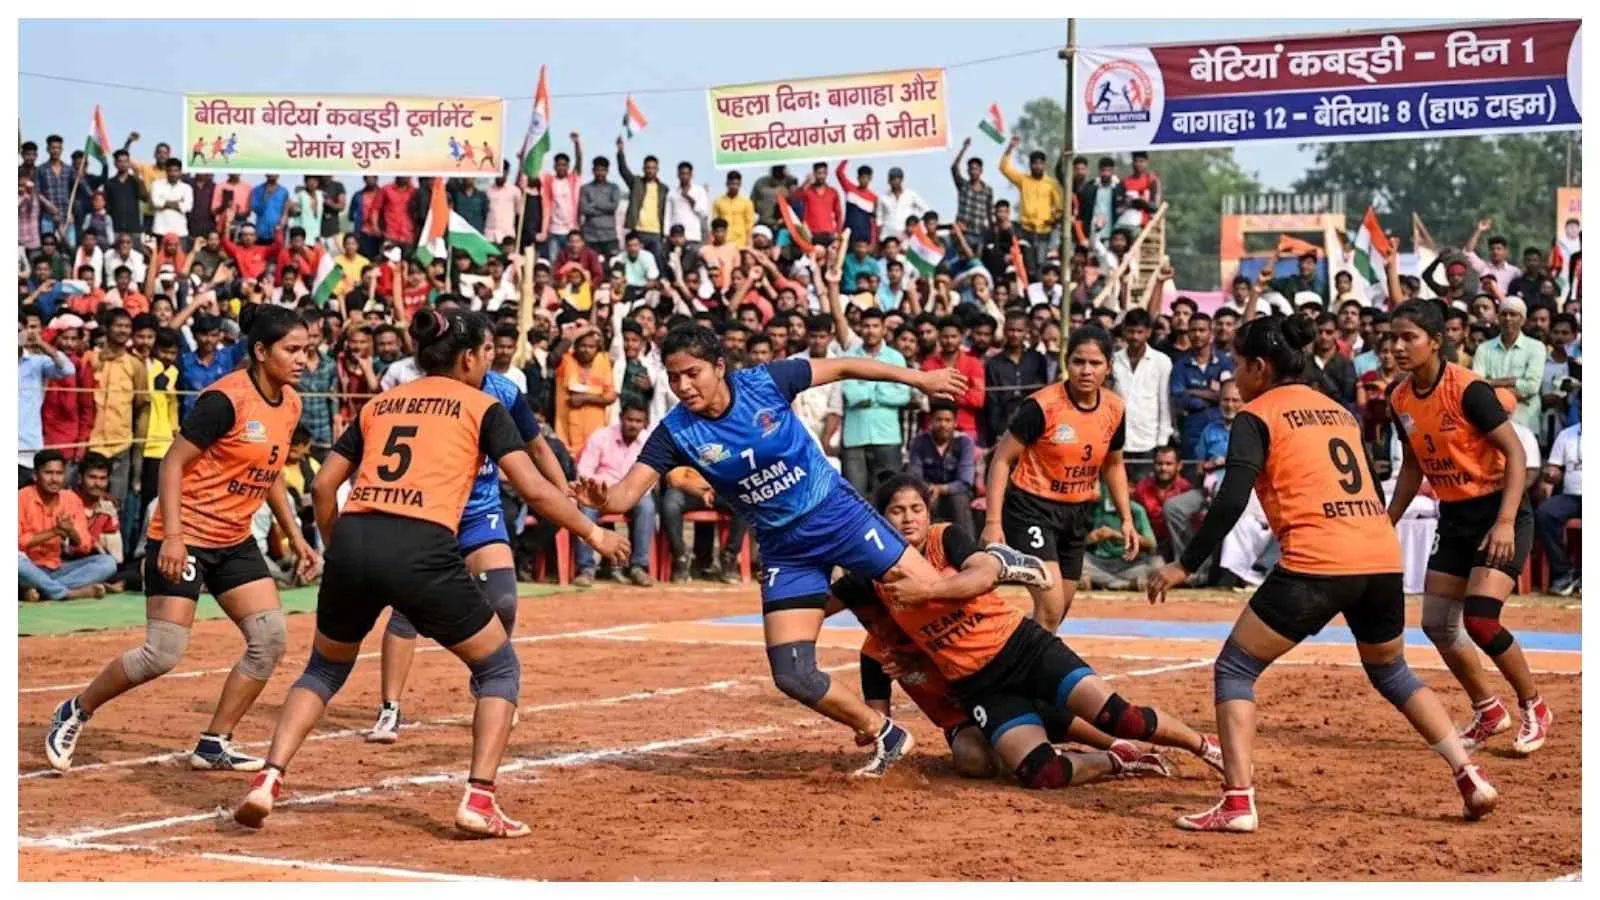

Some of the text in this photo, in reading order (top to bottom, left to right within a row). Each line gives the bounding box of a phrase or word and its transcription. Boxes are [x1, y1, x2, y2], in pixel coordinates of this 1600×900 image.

[1188, 43, 1284, 82] बेटियां
[1445, 30, 1512, 69] दिन
[1522, 37, 1535, 64] 1
[716, 93, 771, 118] पहला
[827, 83, 893, 109] बागाहा
[900, 73, 938, 103] और
[194, 99, 256, 125] बेतिया
[262, 100, 323, 126] बेटियां
[406, 102, 476, 137] टूर्नामेंट
[1264, 107, 1288, 131] 12
[1397, 100, 1412, 124] 8
[1418, 92, 1480, 130] (हाफ
[1485, 85, 1558, 123] टाइम)
[720, 111, 938, 152] नरकटियागंज की जीत!
[285, 134, 345, 159] रोमांच
[372, 397, 462, 420] TEAM BETTIYA
[268, 445, 280, 465] 5
[376, 425, 418, 482] 5
[1081, 443, 1093, 462] 3
[1423, 433, 1436, 454] 3
[740, 447, 757, 470] 7
[1327, 437, 1363, 495] 9
[738, 460, 788, 491] TEAM
[486, 513, 499, 530] 7
[864, 527, 886, 551] 7
[1027, 525, 1045, 549] 3
[182, 555, 197, 582] 5
[767, 568, 780, 588] 7
[973, 704, 989, 728] 9
